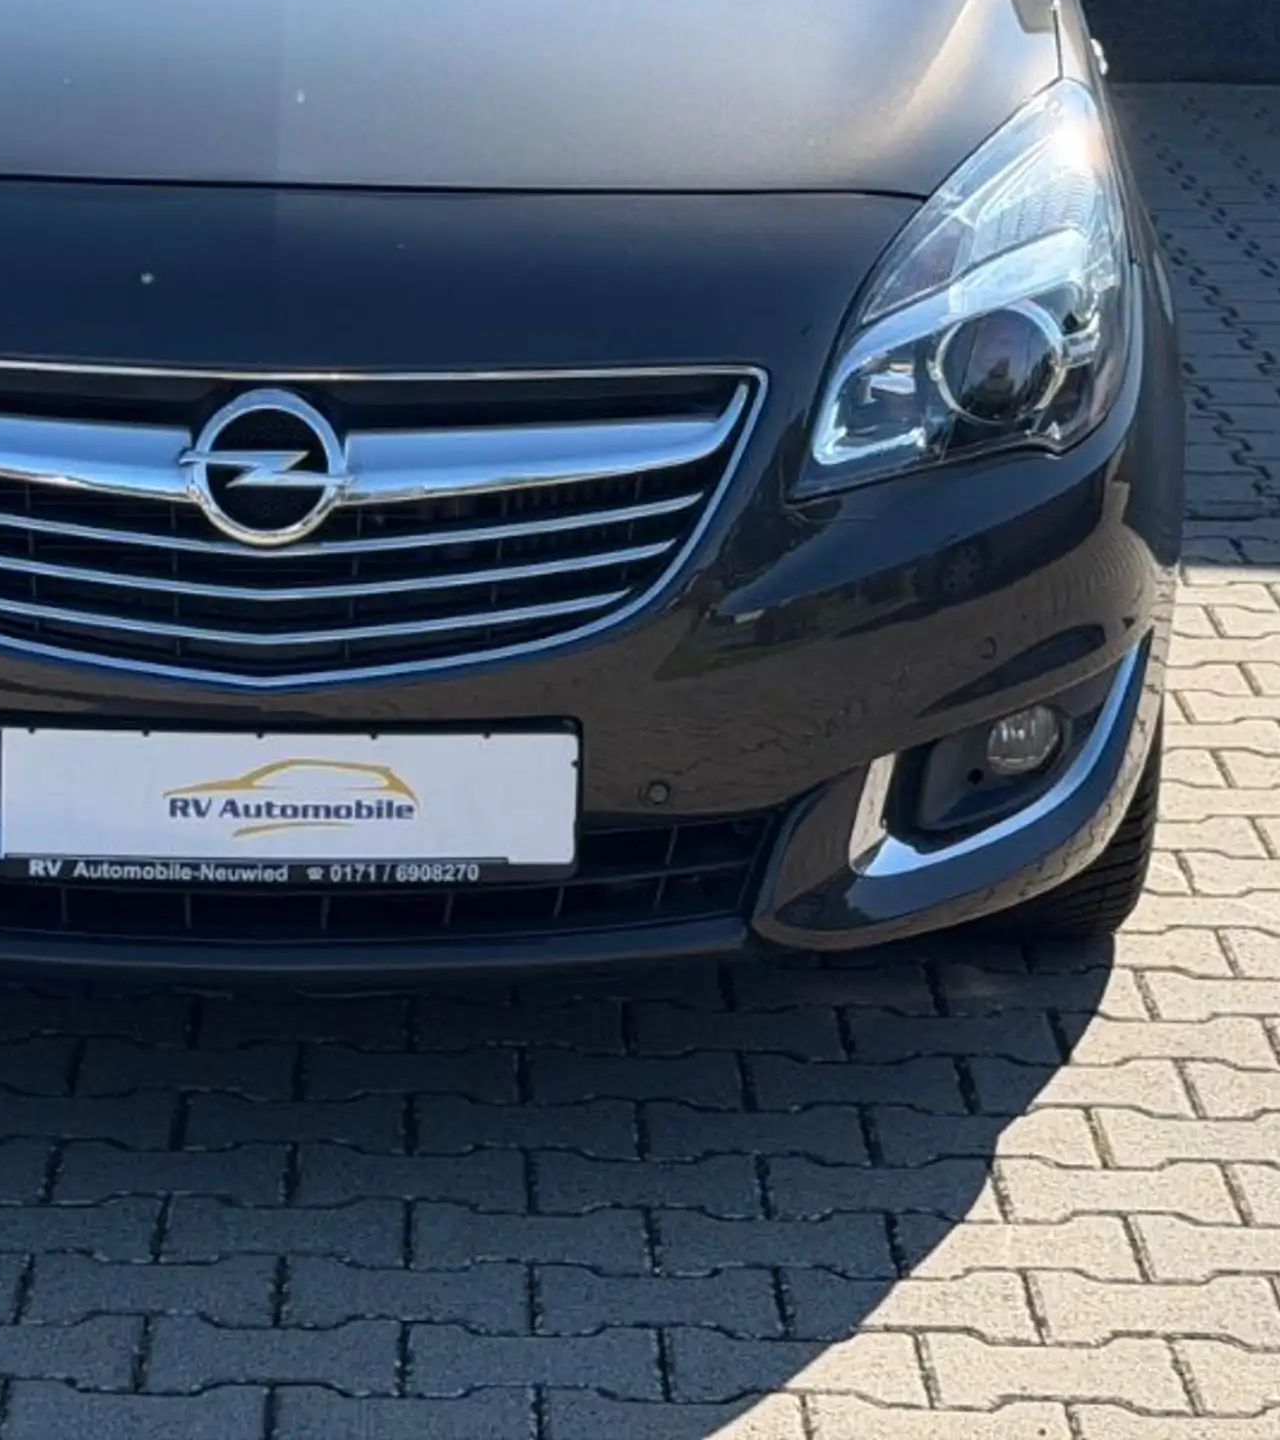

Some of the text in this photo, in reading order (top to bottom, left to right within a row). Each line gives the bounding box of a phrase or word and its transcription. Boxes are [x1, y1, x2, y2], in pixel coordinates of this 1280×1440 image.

[169, 798, 415, 820] RV Automobile
[28, 859, 63, 878] RV
[73, 860, 289, 883] Automobile-Neuwied
